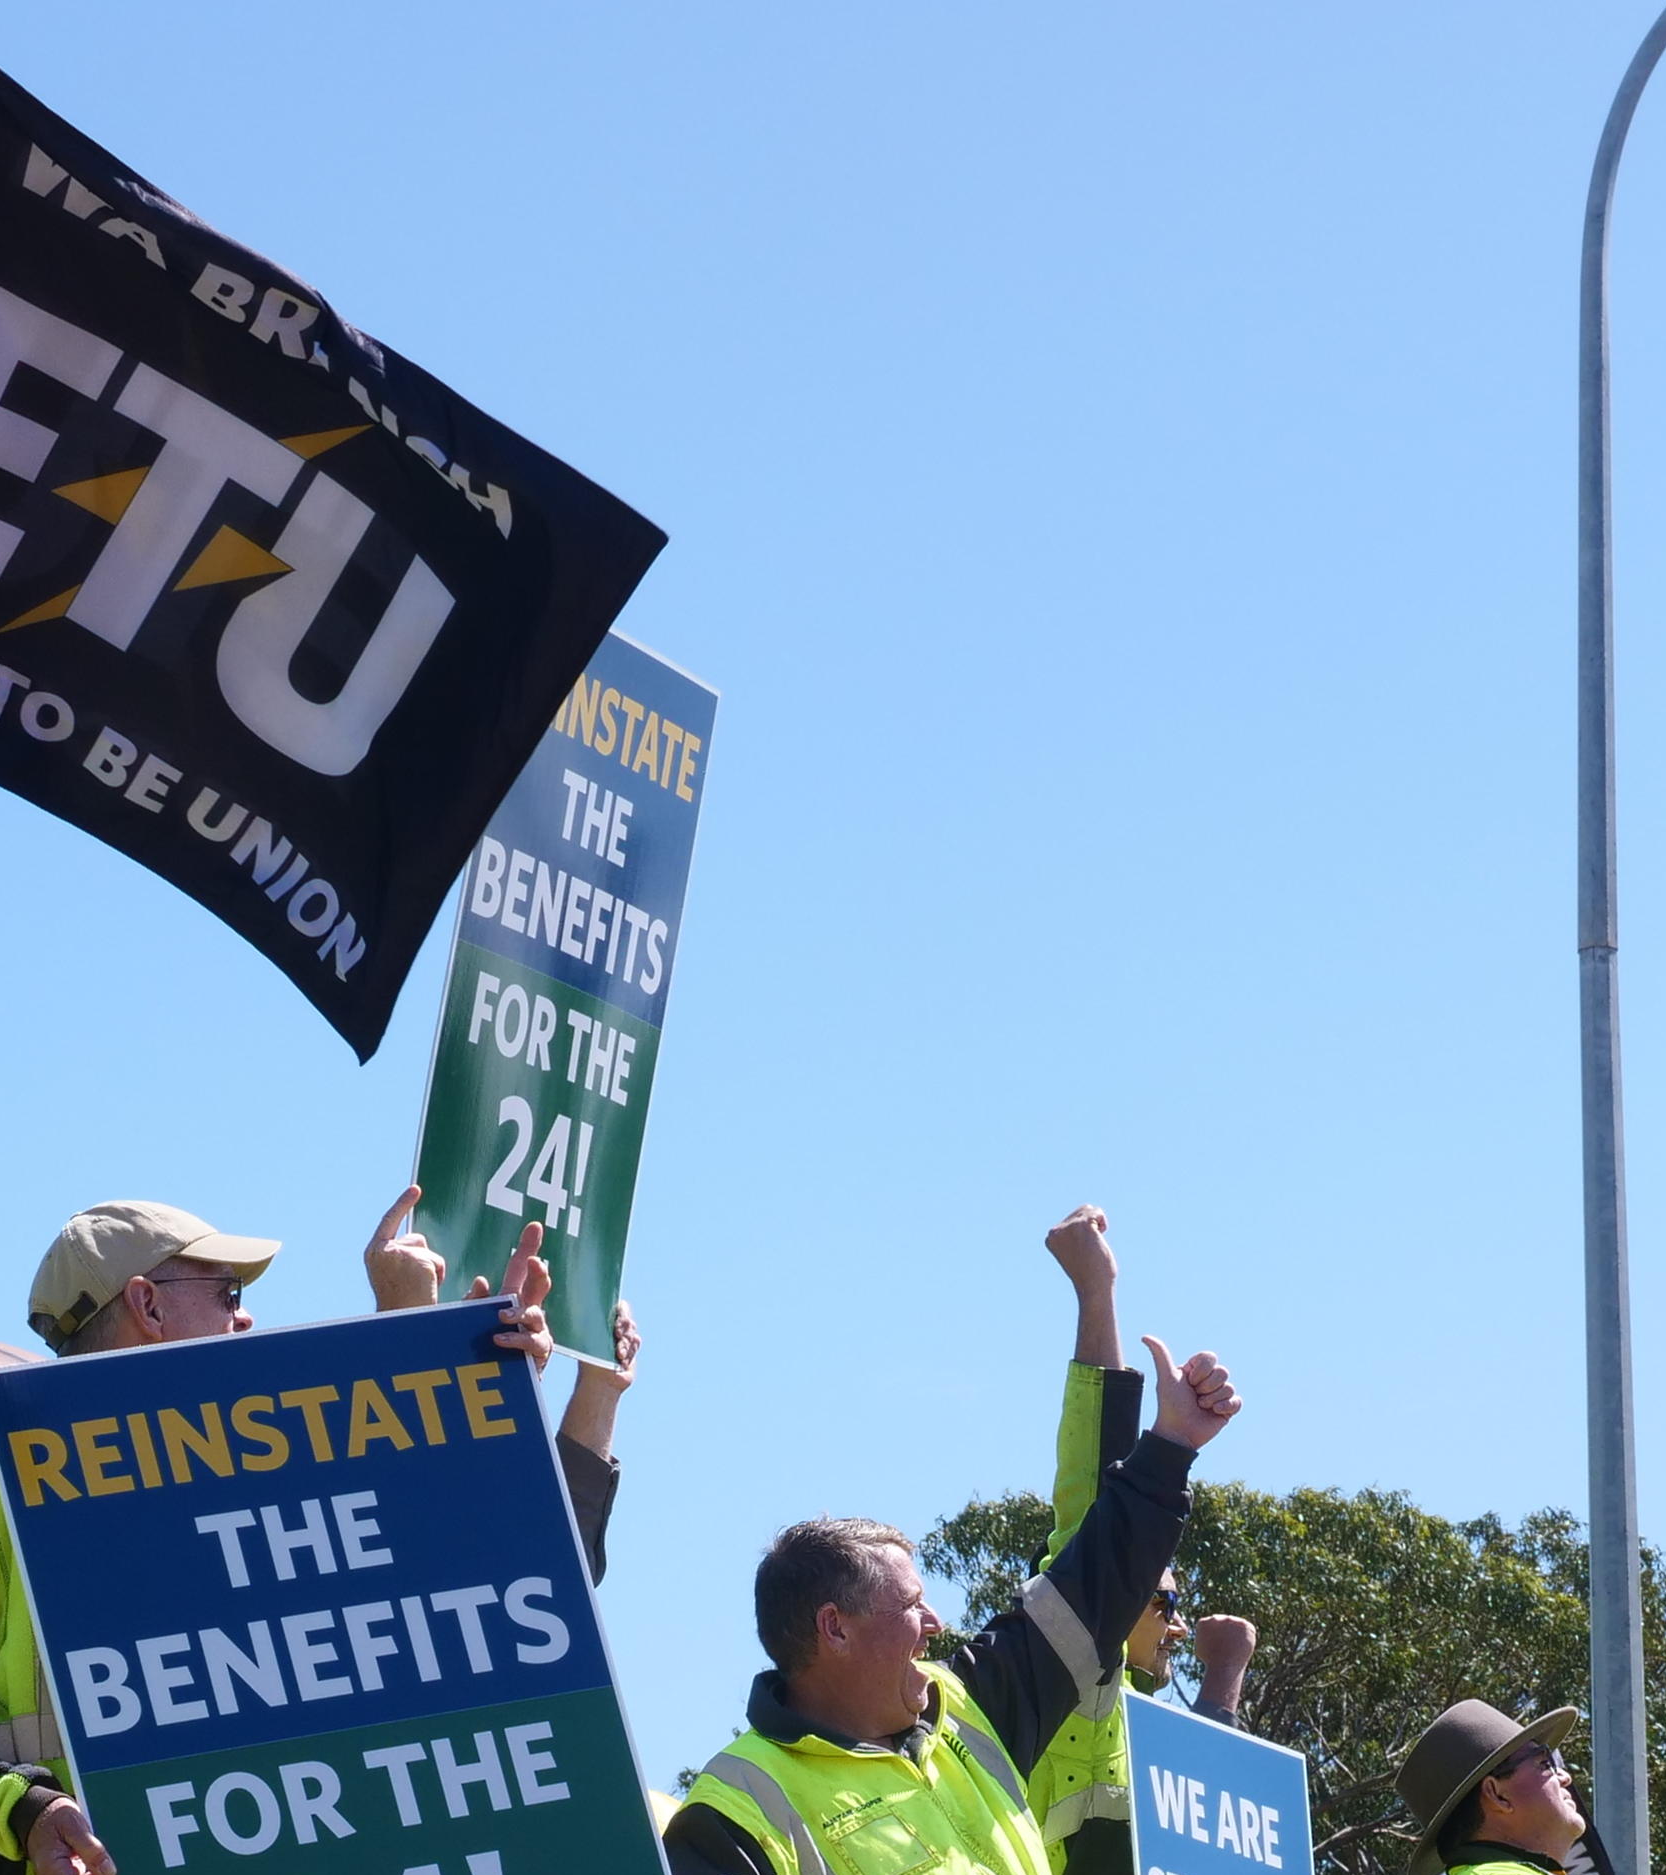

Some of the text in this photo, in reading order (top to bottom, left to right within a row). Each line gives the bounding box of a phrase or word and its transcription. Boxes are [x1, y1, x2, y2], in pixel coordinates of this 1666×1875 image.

[82, 725, 184, 815] BE
[186, 786, 367, 983] UNION
[561, 767, 634, 867] THE
[470, 835, 669, 998] BENEFITS
[468, 971, 636, 1107] FOR THE
[485, 1095, 595, 1239] 24!
[7, 1361, 518, 1507] REINSTATE
[194, 1488, 394, 1589] THE
[65, 1576, 571, 1739] BENEFITS
[144, 1720, 571, 1869] FOR THE
[1149, 1765, 1283, 1870] WE ARE
